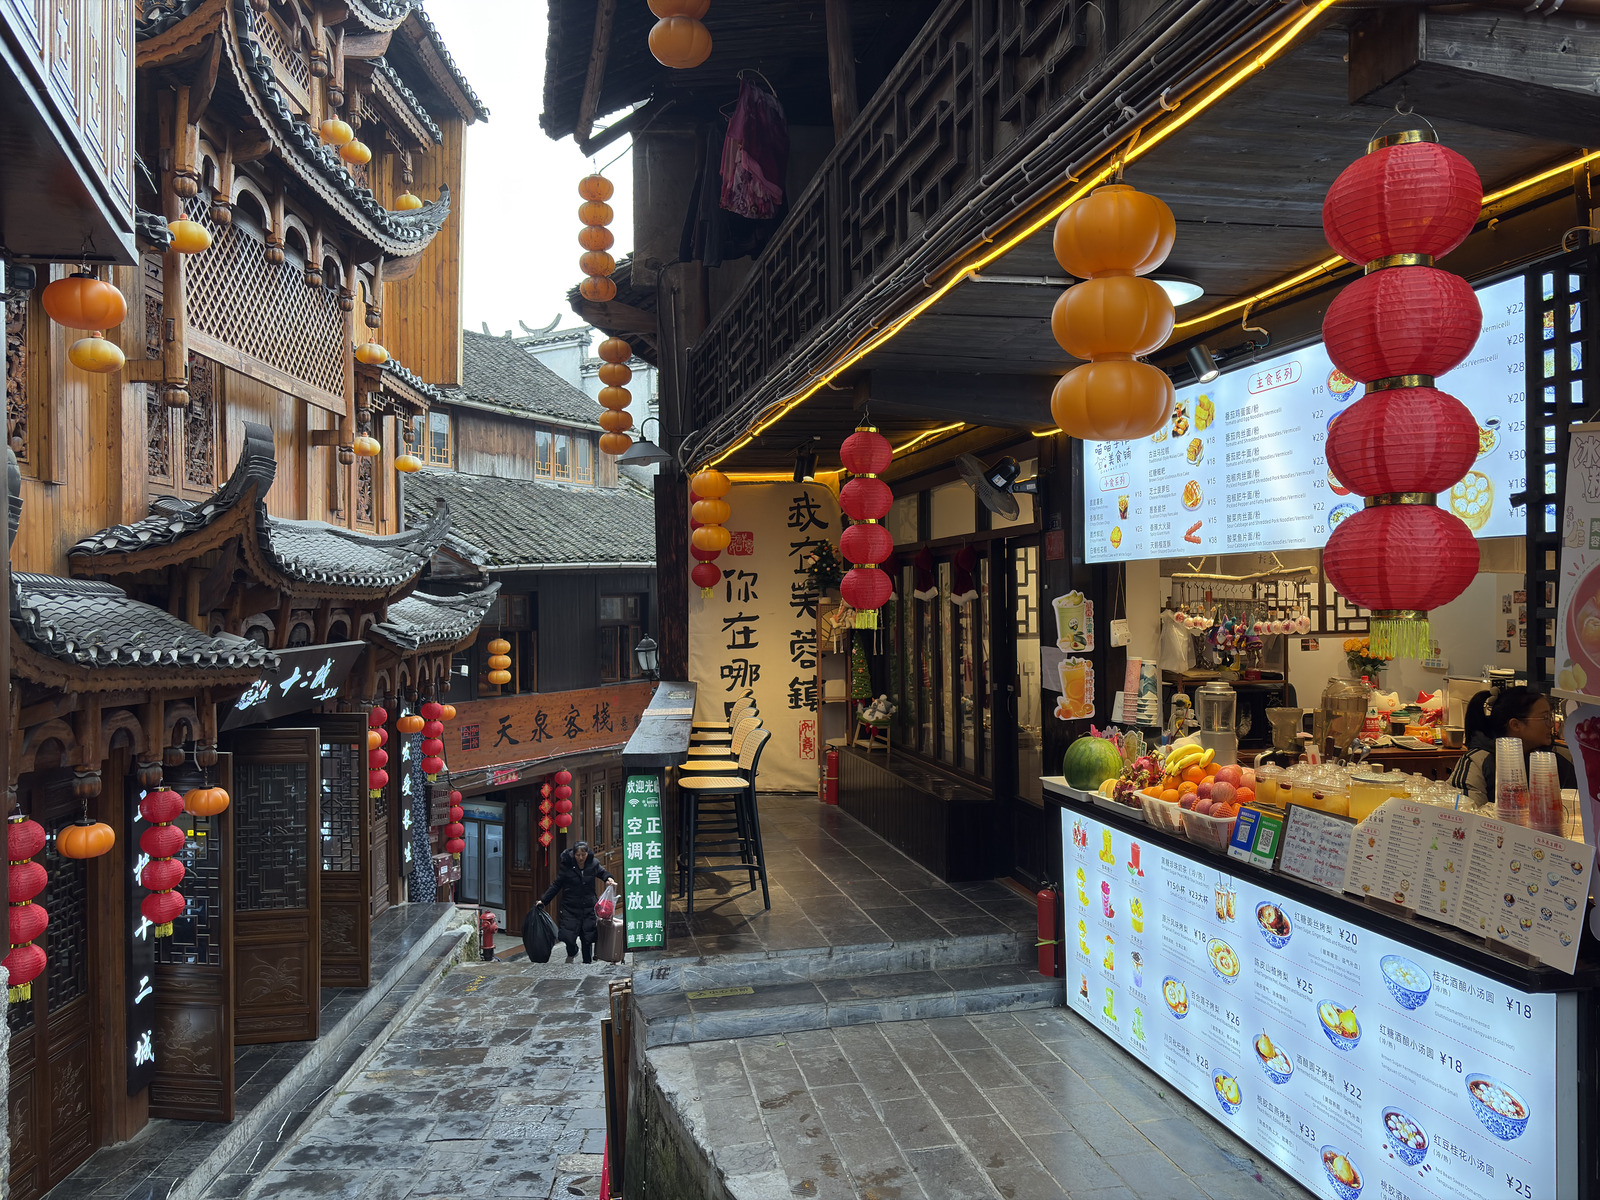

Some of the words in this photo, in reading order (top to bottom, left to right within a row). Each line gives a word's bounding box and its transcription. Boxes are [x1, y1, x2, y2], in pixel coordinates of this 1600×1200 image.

[1507, 302, 1524, 315] ¥22
[1507, 333, 1524, 345] ¥28
[1508, 362, 1524, 374] ¥28
[1257, 368, 1292, 388] 主食系列
[1312, 385, 1323, 395] ¥18
[1508, 392, 1525, 404] ¥20
[1312, 410, 1324, 419] ¥22
[1508, 422, 1525, 432] ¥25
[1313, 433, 1324, 441] ¥28
[1313, 457, 1324, 465] ¥22
[1508, 450, 1526, 460] ¥30
[1104, 476, 1125, 487] 小食系列
[1313, 480, 1324, 488] ¥28
[1509, 478, 1526, 488] ¥18
[1314, 502, 1324, 510] ¥22
[1509, 507, 1526, 517] ¥15
[1314, 525, 1324, 533] ¥28
[720, 569, 760, 722] 你在哪
[627, 817, 643, 910] 空调开放
[646, 817, 662, 909] 正在营业
[134, 790, 154, 1066] 十二城
[628, 920, 662, 930] 推门请进
[628, 934, 662, 943] 随手关门
[1194, 929, 1206, 943] ¥18
[1339, 928, 1357, 945] ¥20
[1296, 976, 1313, 994] ¥25
[1433, 970, 1494, 1004] 桂花酒酿小汤圆
[1506, 997, 1532, 1019] ¥18
[1226, 1010, 1240, 1026] ¥26
[1196, 1053, 1208, 1069] ¥28
[1440, 1052, 1462, 1073] ¥18
[1343, 1080, 1362, 1101] ¥22
[1299, 1121, 1316, 1141] ¥33
[1434, 1134, 1494, 1178] 红豆桂花小汤圆
[1506, 1173, 1532, 1199] ¥25
